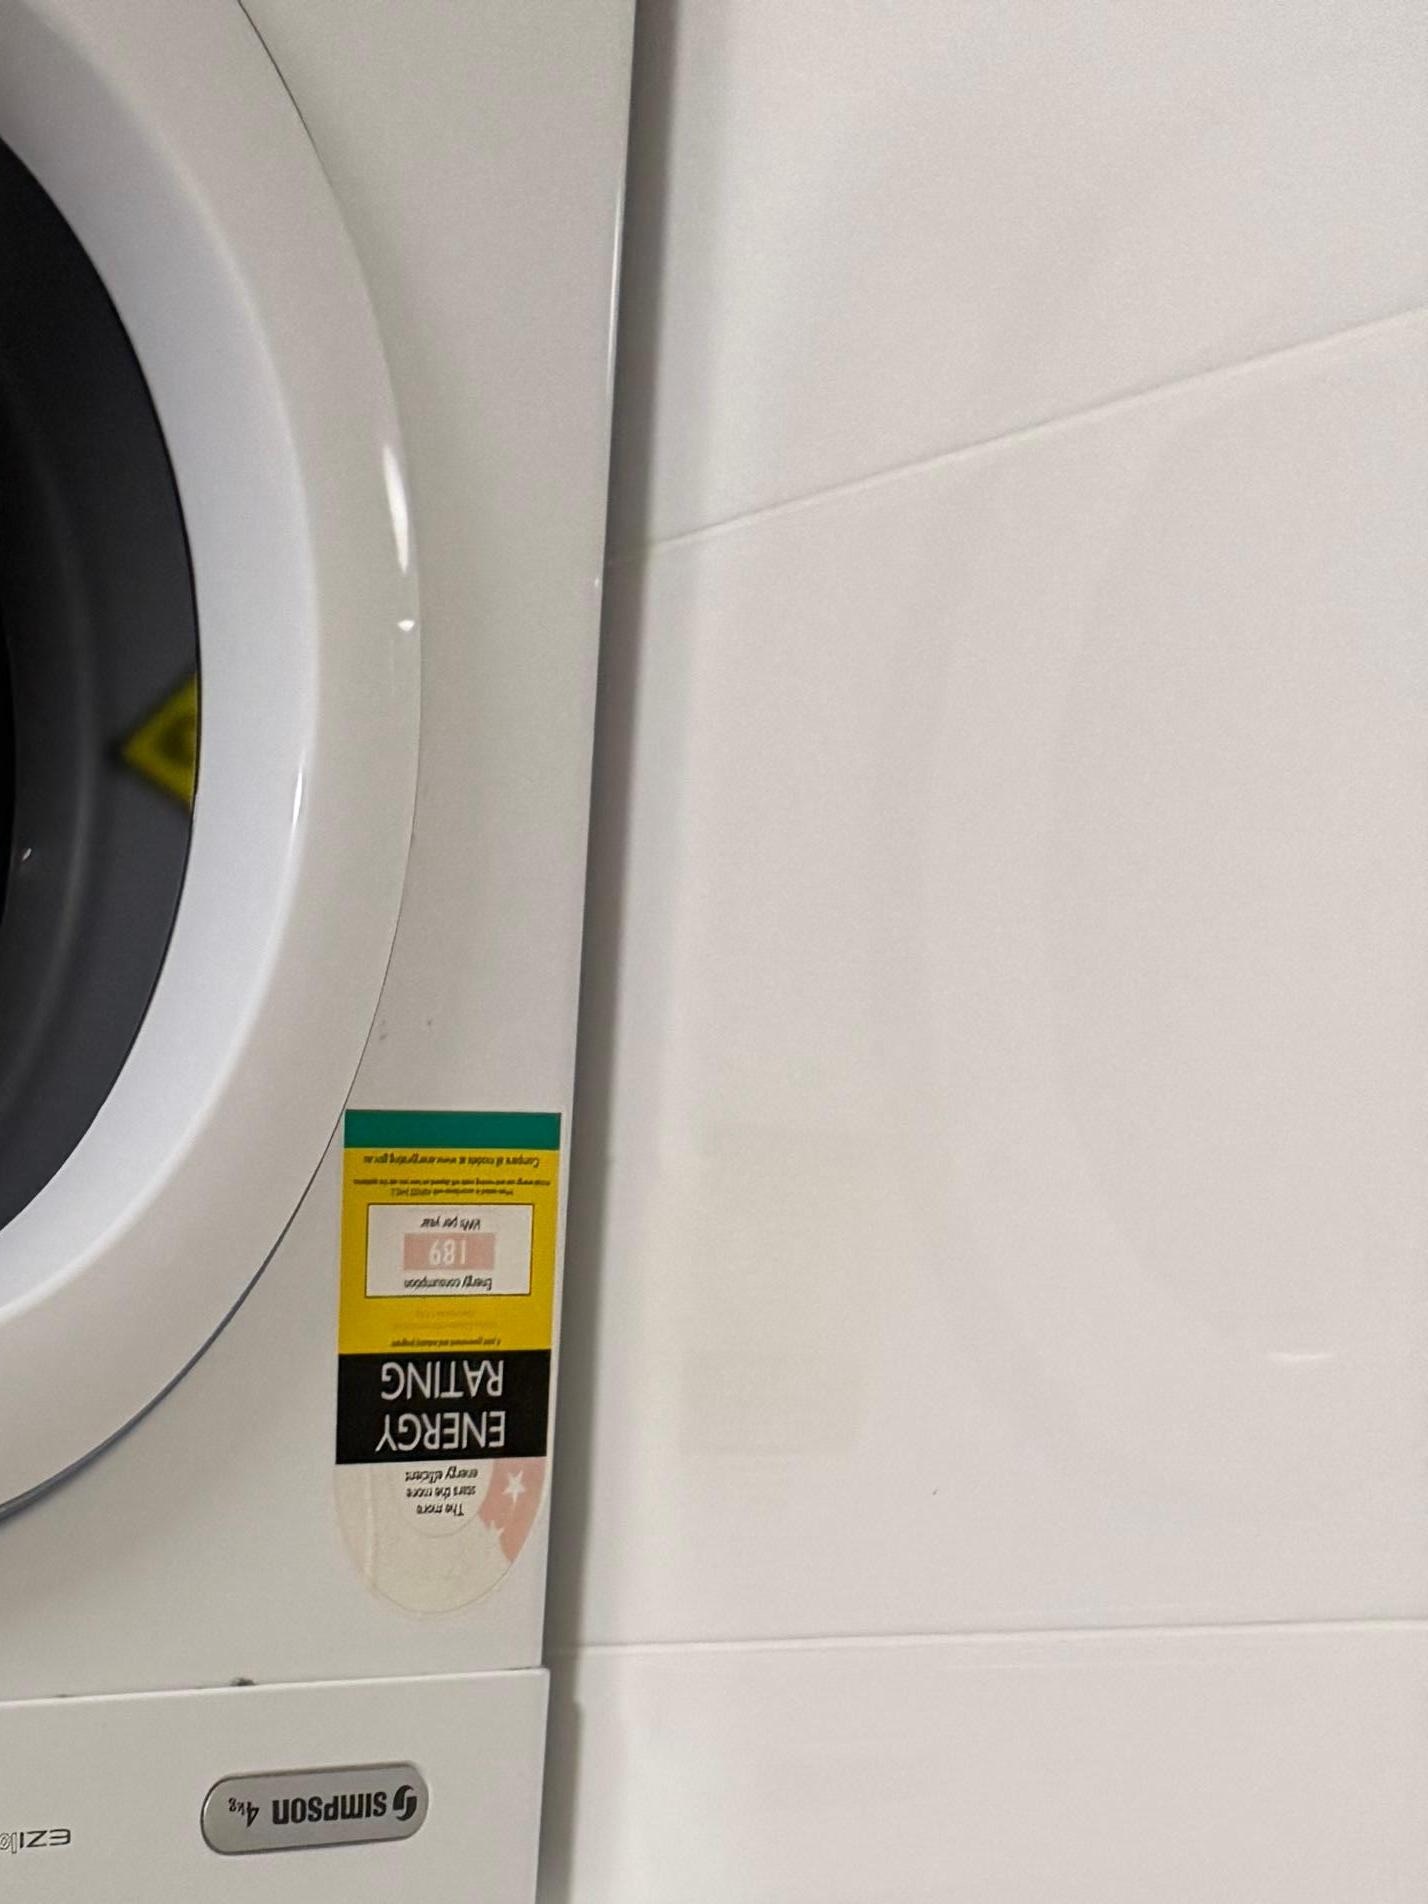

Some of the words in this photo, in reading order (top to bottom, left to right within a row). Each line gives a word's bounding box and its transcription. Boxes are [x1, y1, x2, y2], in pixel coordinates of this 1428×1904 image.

[420, 1216, 441, 1229] year
[443, 1216, 458, 1229] per
[428, 1239, 467, 1266] 189
[404, 1276, 460, 1291] consumption
[462, 1275, 492, 1291] Energy
[381, 1360, 504, 1400] RATING
[375, 1410, 506, 1452] ENERGY
[405, 1470, 443, 1483] efficient
[445, 1466, 478, 1481] energy
[406, 1487, 433, 1497] more
[435, 1487, 450, 1499] the
[453, 1485, 476, 1499] stars
[416, 1504, 443, 1514] more
[445, 1503, 464, 1516] The
[271, 1790, 388, 1827] SIMPSON
